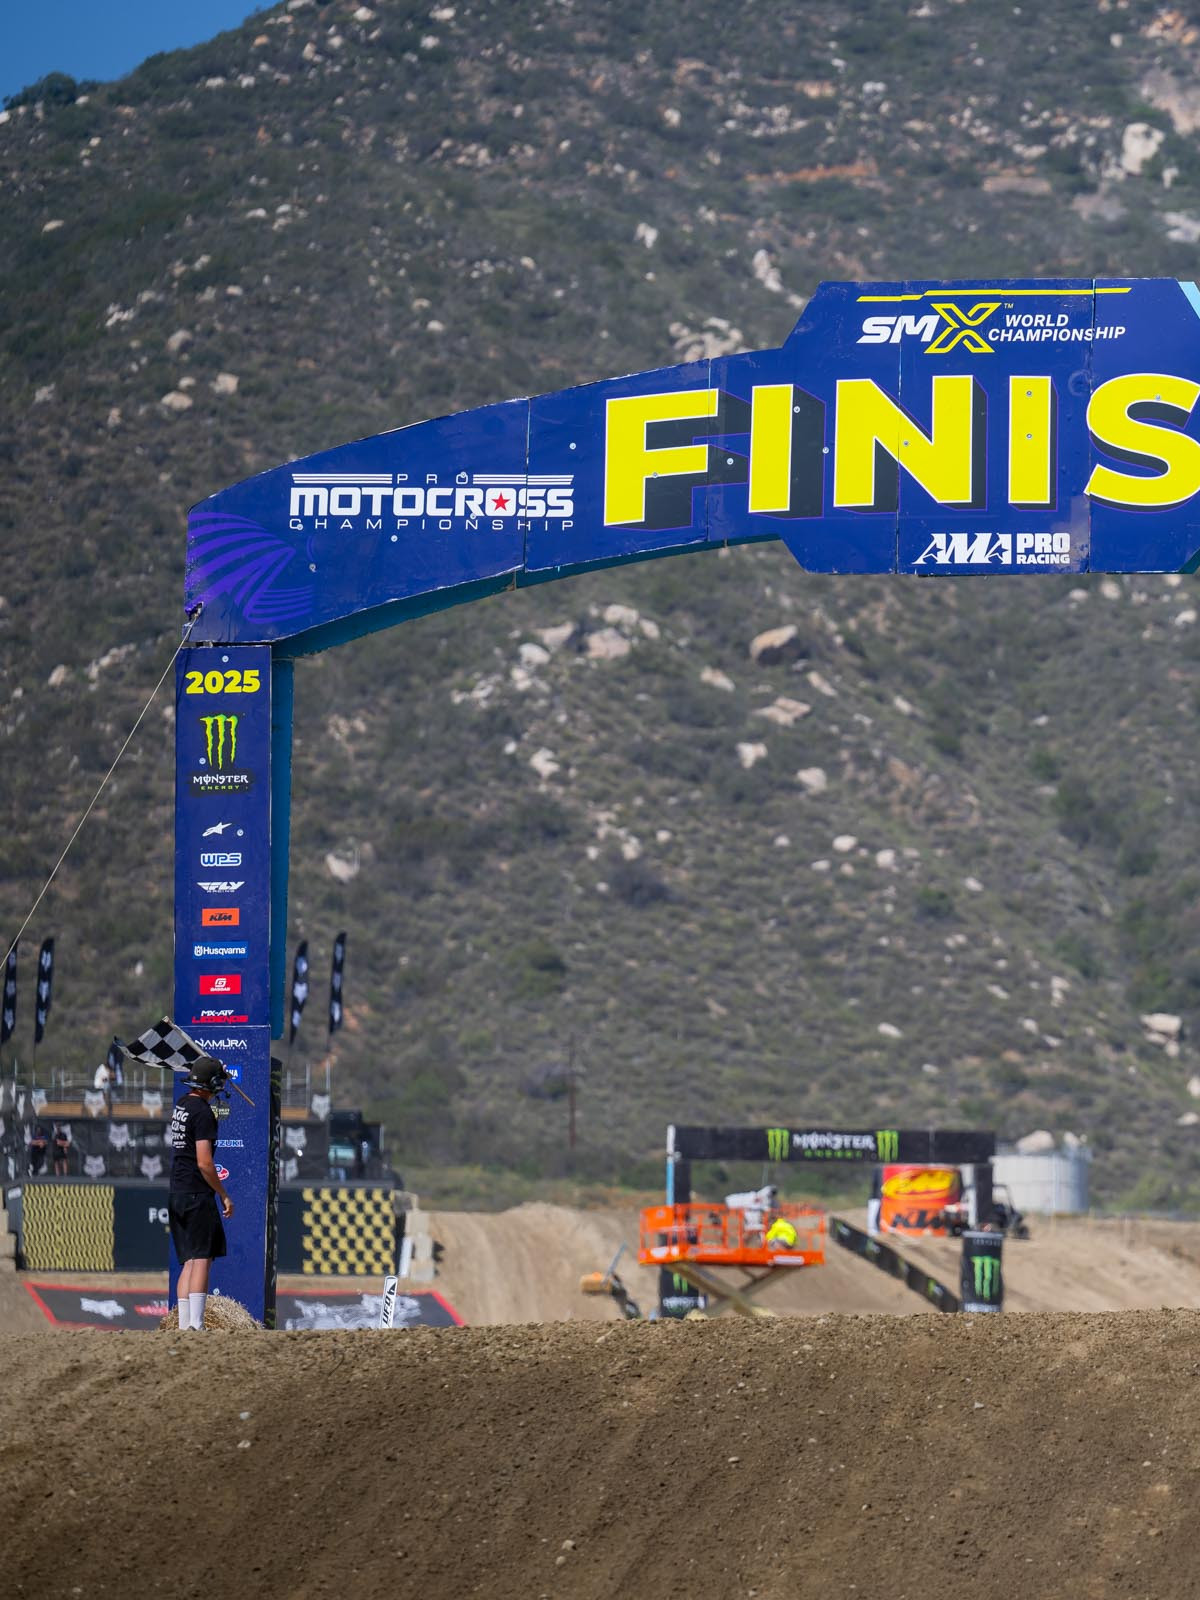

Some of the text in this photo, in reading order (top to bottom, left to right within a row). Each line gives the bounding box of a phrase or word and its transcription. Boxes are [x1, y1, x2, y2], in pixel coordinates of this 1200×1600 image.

[1005, 314, 1069, 327] WORLD
[856, 303, 1001, 353] SMX
[988, 327, 1126, 342] CHAMPIONSHIP
[397, 472, 469, 484] PRO
[290, 487, 575, 518] MOTOCROSS
[289, 519, 574, 531] CHAMPIONSHIP
[911, 533, 1012, 565] AMA
[1017, 533, 1071, 553] PRO
[1017, 554, 1071, 565] RACING
[185, 670, 261, 694] 2025
[193, 774, 248, 785] MONSTER
[201, 853, 242, 867] WPS
[202, 882, 245, 891] FLY
[209, 913, 232, 922] KTM
[203, 946, 246, 956] Husqvarna
[195, 1038, 248, 1048] NAMURA
[793, 1133, 875, 1149] MONSTER
[383, 1295, 391, 1324] UFO
